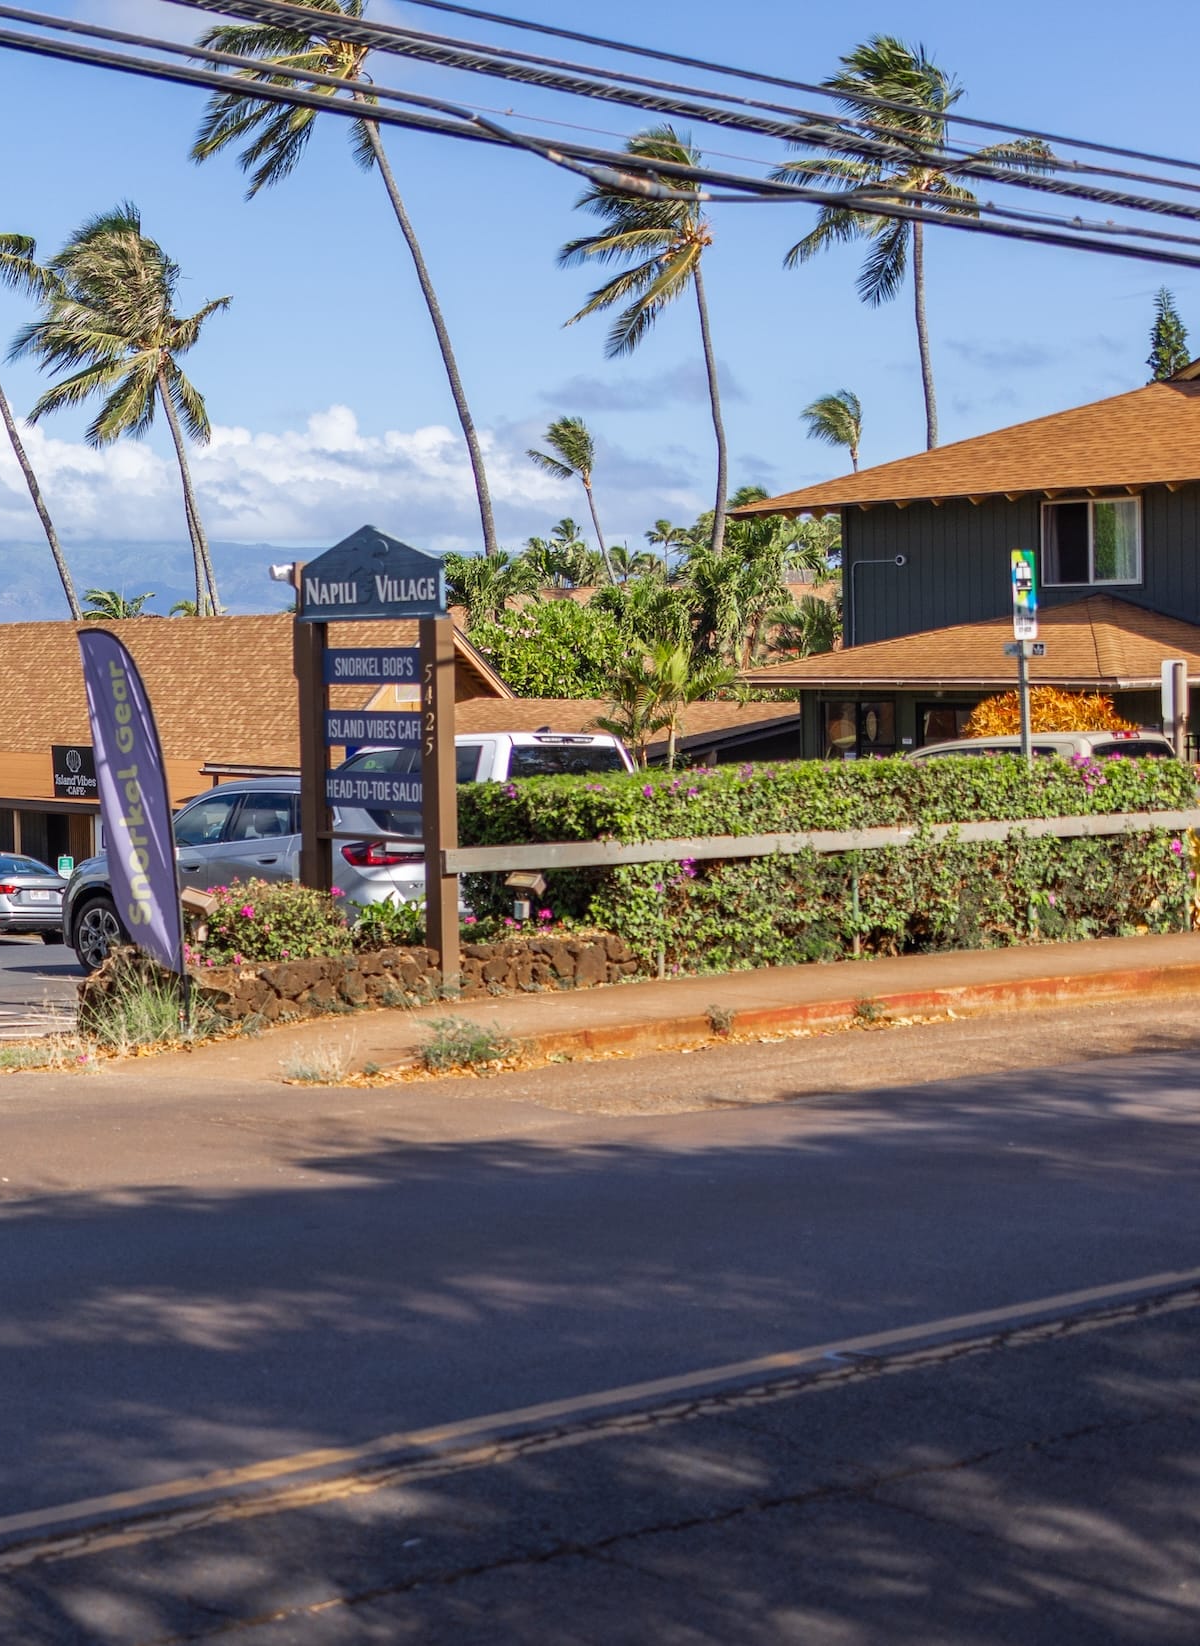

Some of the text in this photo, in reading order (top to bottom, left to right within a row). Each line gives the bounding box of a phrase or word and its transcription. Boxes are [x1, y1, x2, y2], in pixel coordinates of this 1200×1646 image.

[305, 575, 436, 606] NAPILI VILLAGE
[334, 656, 414, 677] SNORKEL BOB'S
[109, 660, 134, 754] Gear
[327, 719, 365, 738] ISLAND
[366, 719, 397, 739] VIBES
[326, 779, 391, 801] HEAD-TO-TOE
